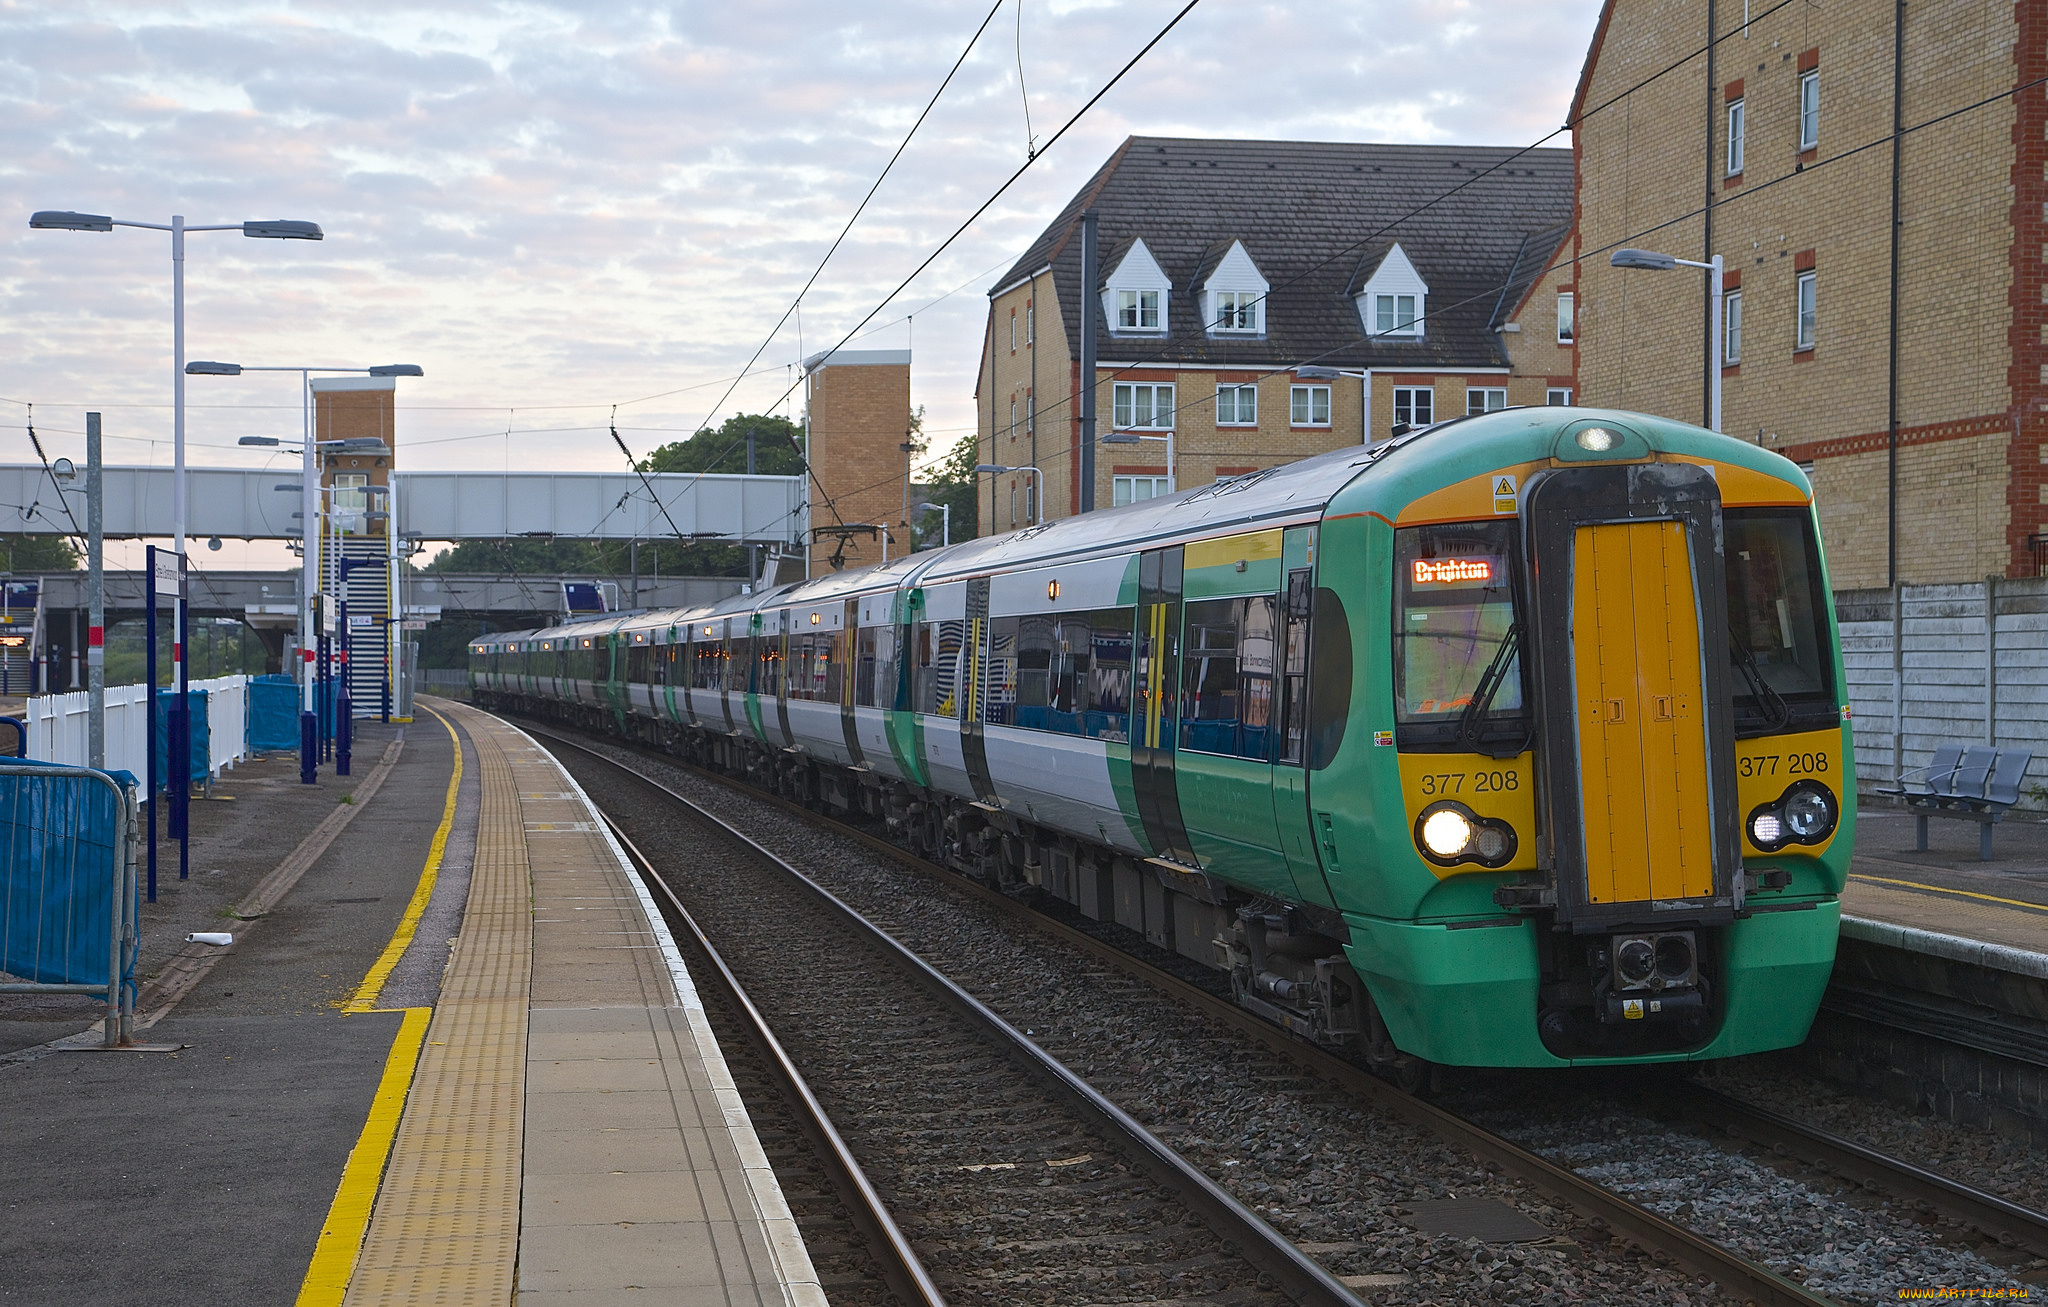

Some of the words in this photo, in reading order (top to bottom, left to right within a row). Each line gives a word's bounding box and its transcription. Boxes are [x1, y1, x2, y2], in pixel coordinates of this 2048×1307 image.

[1415, 559, 1490, 583] Brighton
[1739, 755, 1780, 777] 377
[1787, 752, 1829, 774] 208
[1421, 773, 1466, 795] 377
[1474, 770, 1519, 793] 208
